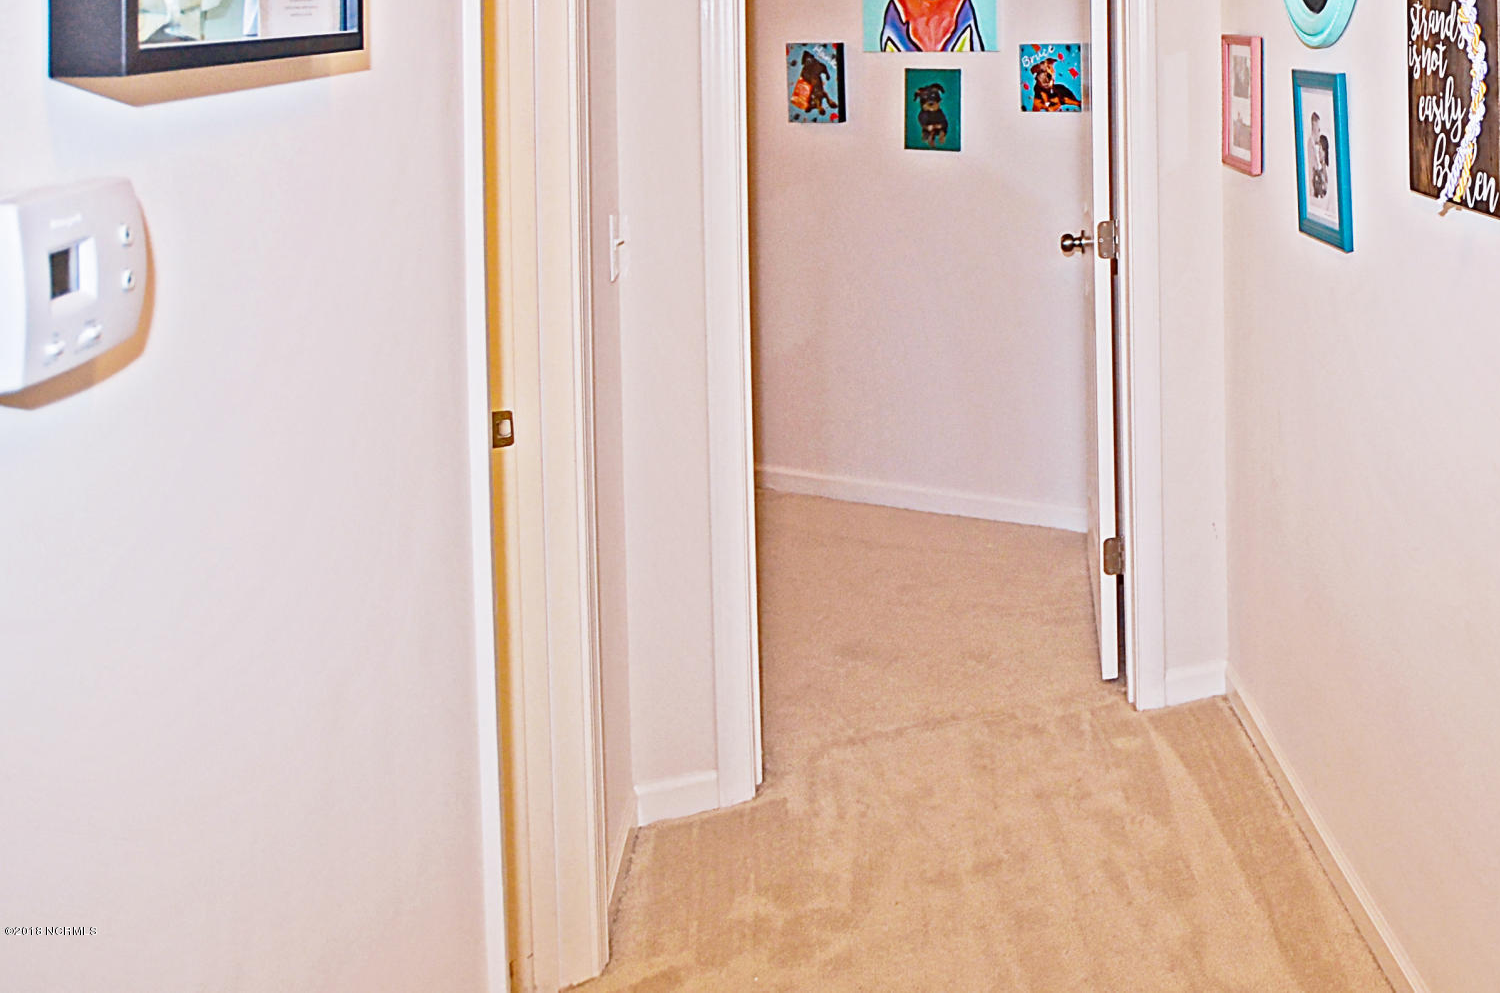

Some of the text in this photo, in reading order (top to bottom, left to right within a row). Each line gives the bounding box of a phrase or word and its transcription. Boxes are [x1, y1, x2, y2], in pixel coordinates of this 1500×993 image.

[1408, 40, 1448, 80] is not
[1418, 75, 1467, 144] easily
[1432, 132, 1500, 214] brken
